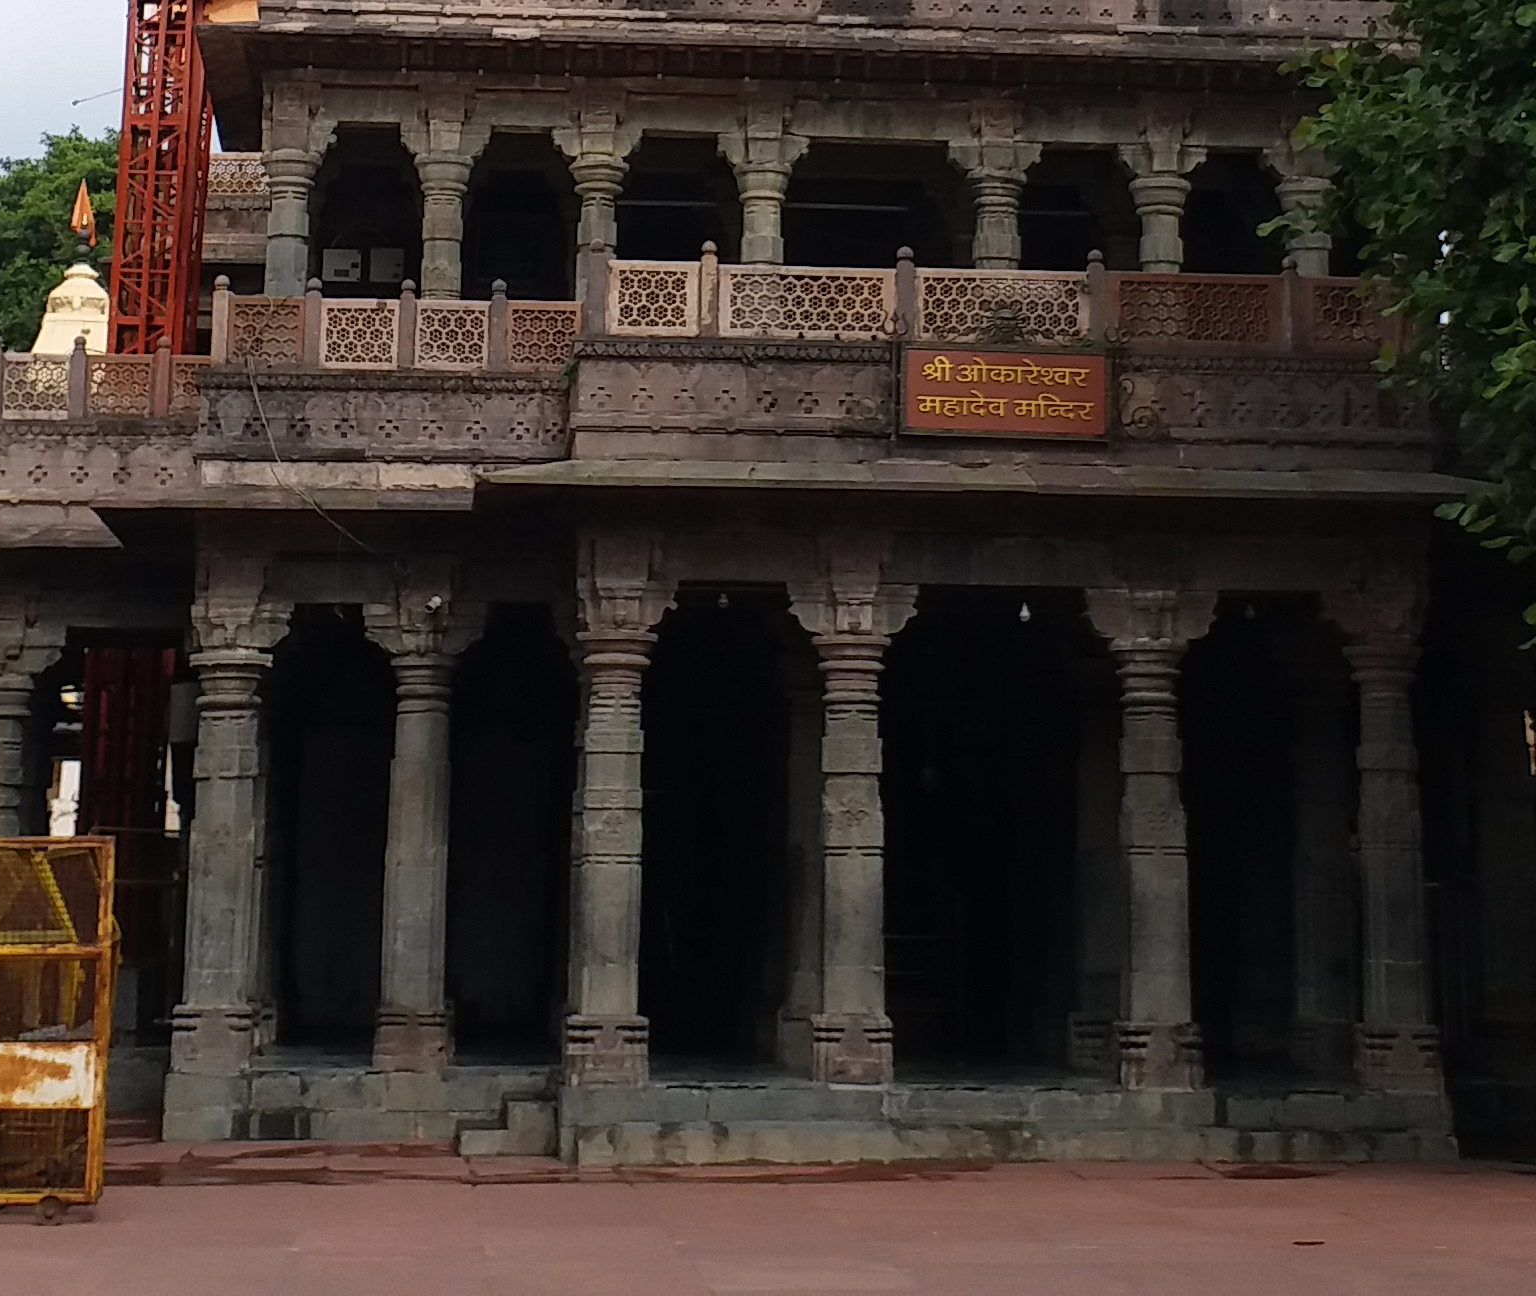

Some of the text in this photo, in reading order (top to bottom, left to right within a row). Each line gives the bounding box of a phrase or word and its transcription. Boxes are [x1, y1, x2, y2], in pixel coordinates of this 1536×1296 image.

[921, 355, 1091, 388] श्री ओकारेश्वर
[916, 390, 1096, 421] महादेव मन्दिर
